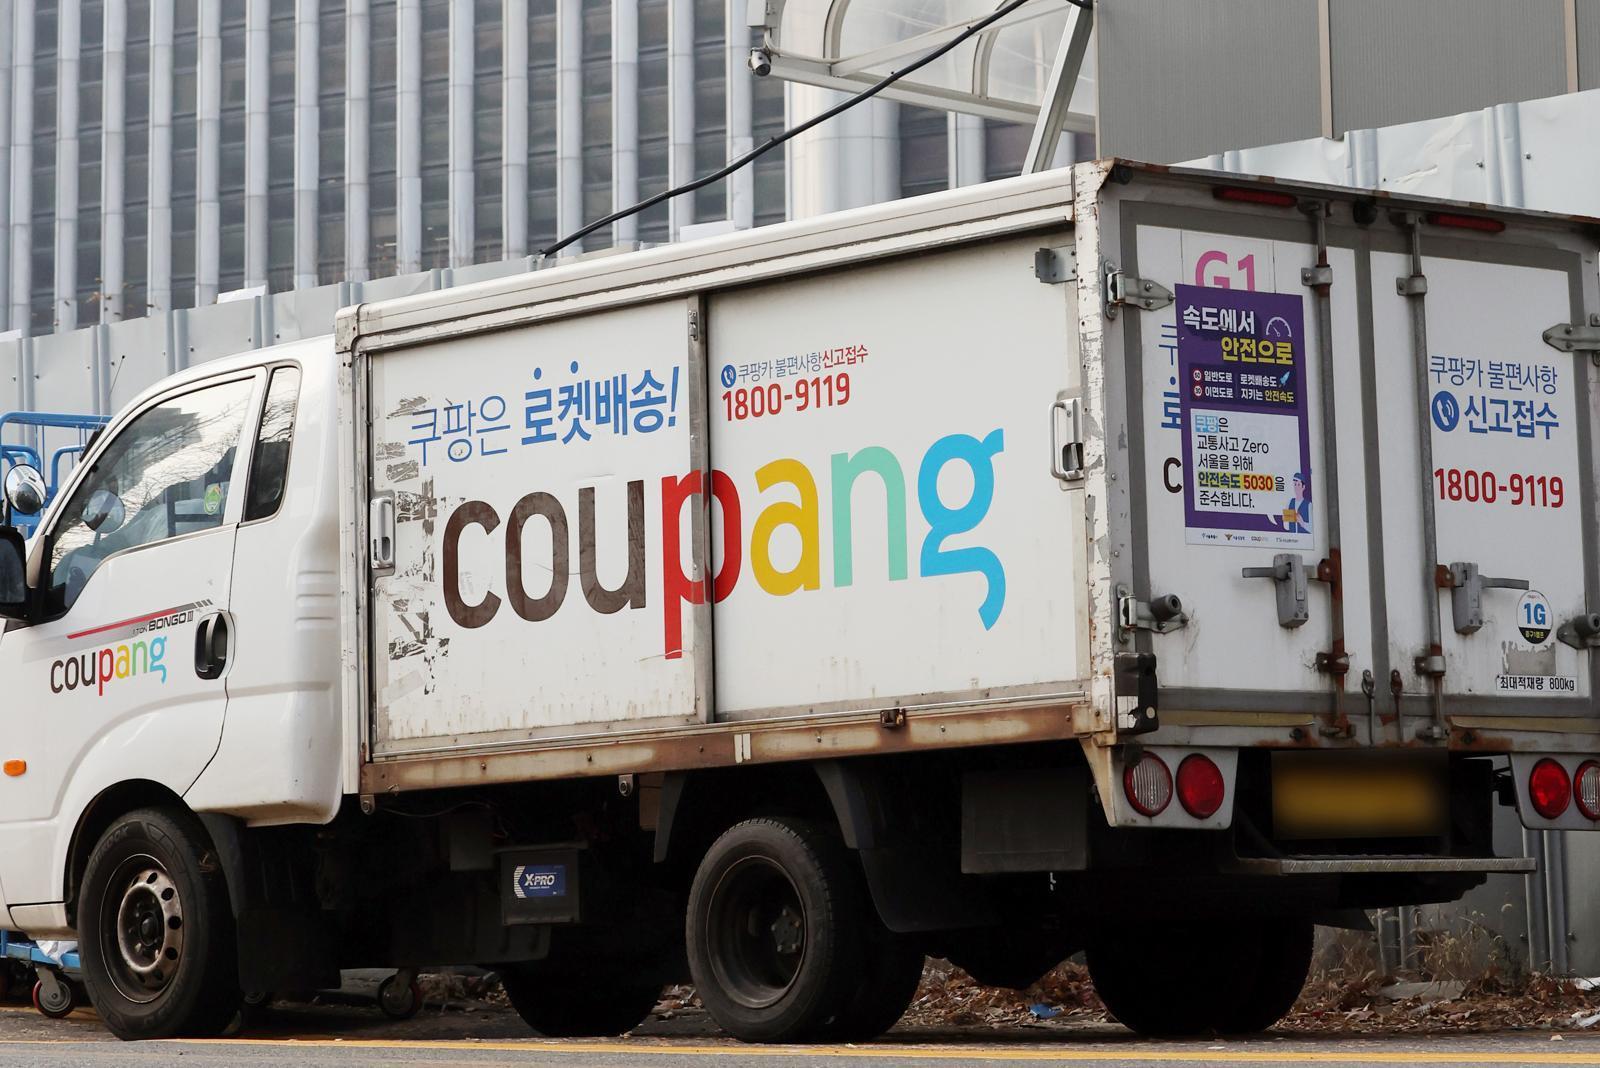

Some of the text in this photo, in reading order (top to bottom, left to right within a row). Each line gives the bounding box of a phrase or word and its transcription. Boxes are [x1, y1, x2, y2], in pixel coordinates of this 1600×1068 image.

[1195, 250, 1255, 292] G1
[1183, 305, 1255, 334] 속도에서
[1221, 336, 1293, 365] 안전으로
[738, 360, 773, 383] 쿠팡카
[1204, 370, 1233, 383] 일반도로
[1240, 373, 1277, 387] 로켓배송도
[1430, 355, 1558, 395] 쿠팡카 불편사항
[722, 372, 850, 421] 1800-9119
[1204, 386, 1234, 399] 이면도로
[1240, 388, 1295, 403] 지키는 안전속도
[407, 361, 680, 467] 쿠팡은 로켓배송!
[1195, 415, 1229, 433] 쿠팡은
[1464, 395, 1559, 440] 신고접수
[1197, 435, 1269, 454] 교통사고 Zero
[1198, 453, 1253, 471] 서울을 위해
[1198, 472, 1240, 489] 안전속도
[1434, 468, 1564, 508] 1800-9119
[1200, 490, 1255, 508] 준수합니다.
[442, 428, 1006, 660] coupang
[148, 612, 186, 632] BONGO
[1523, 602, 1546, 625] 1G
[50, 636, 167, 696] coupang
[1500, 676, 1575, 691] 최대적재량 800kg
